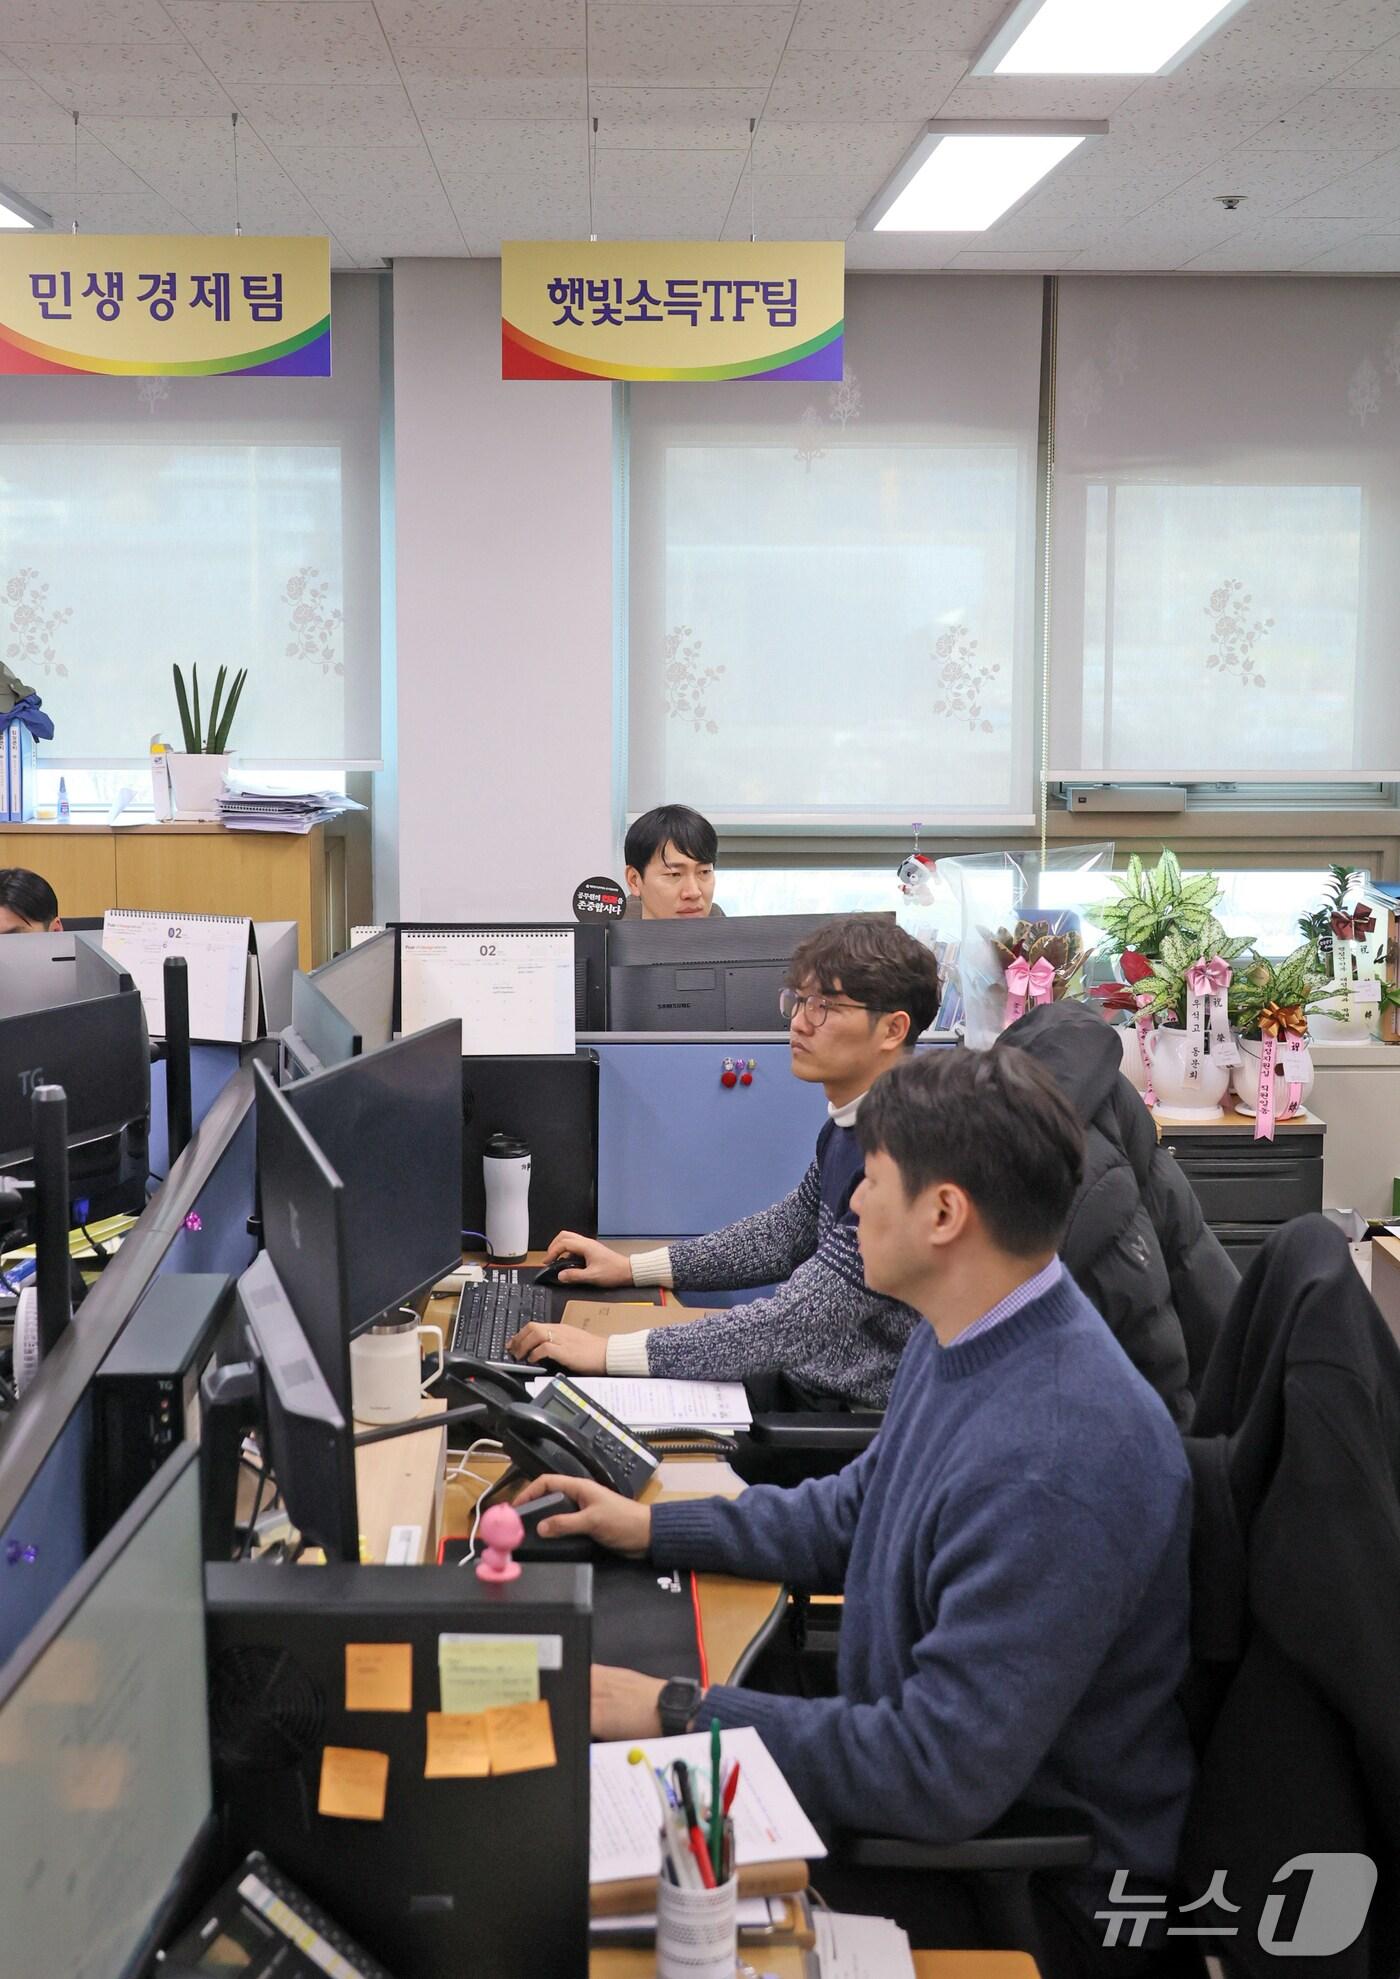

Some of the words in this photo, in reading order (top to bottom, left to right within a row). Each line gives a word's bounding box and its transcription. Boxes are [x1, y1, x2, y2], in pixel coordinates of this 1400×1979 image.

[29, 272, 283, 322] 민생경제팀
[547, 277, 797, 327] 햇빛소득TF팀
[578, 900, 622, 915] 존중합시다
[168, 927, 182, 939] 02
[479, 945, 497, 956] 02
[1191, 999, 1201, 1033] 우석고
